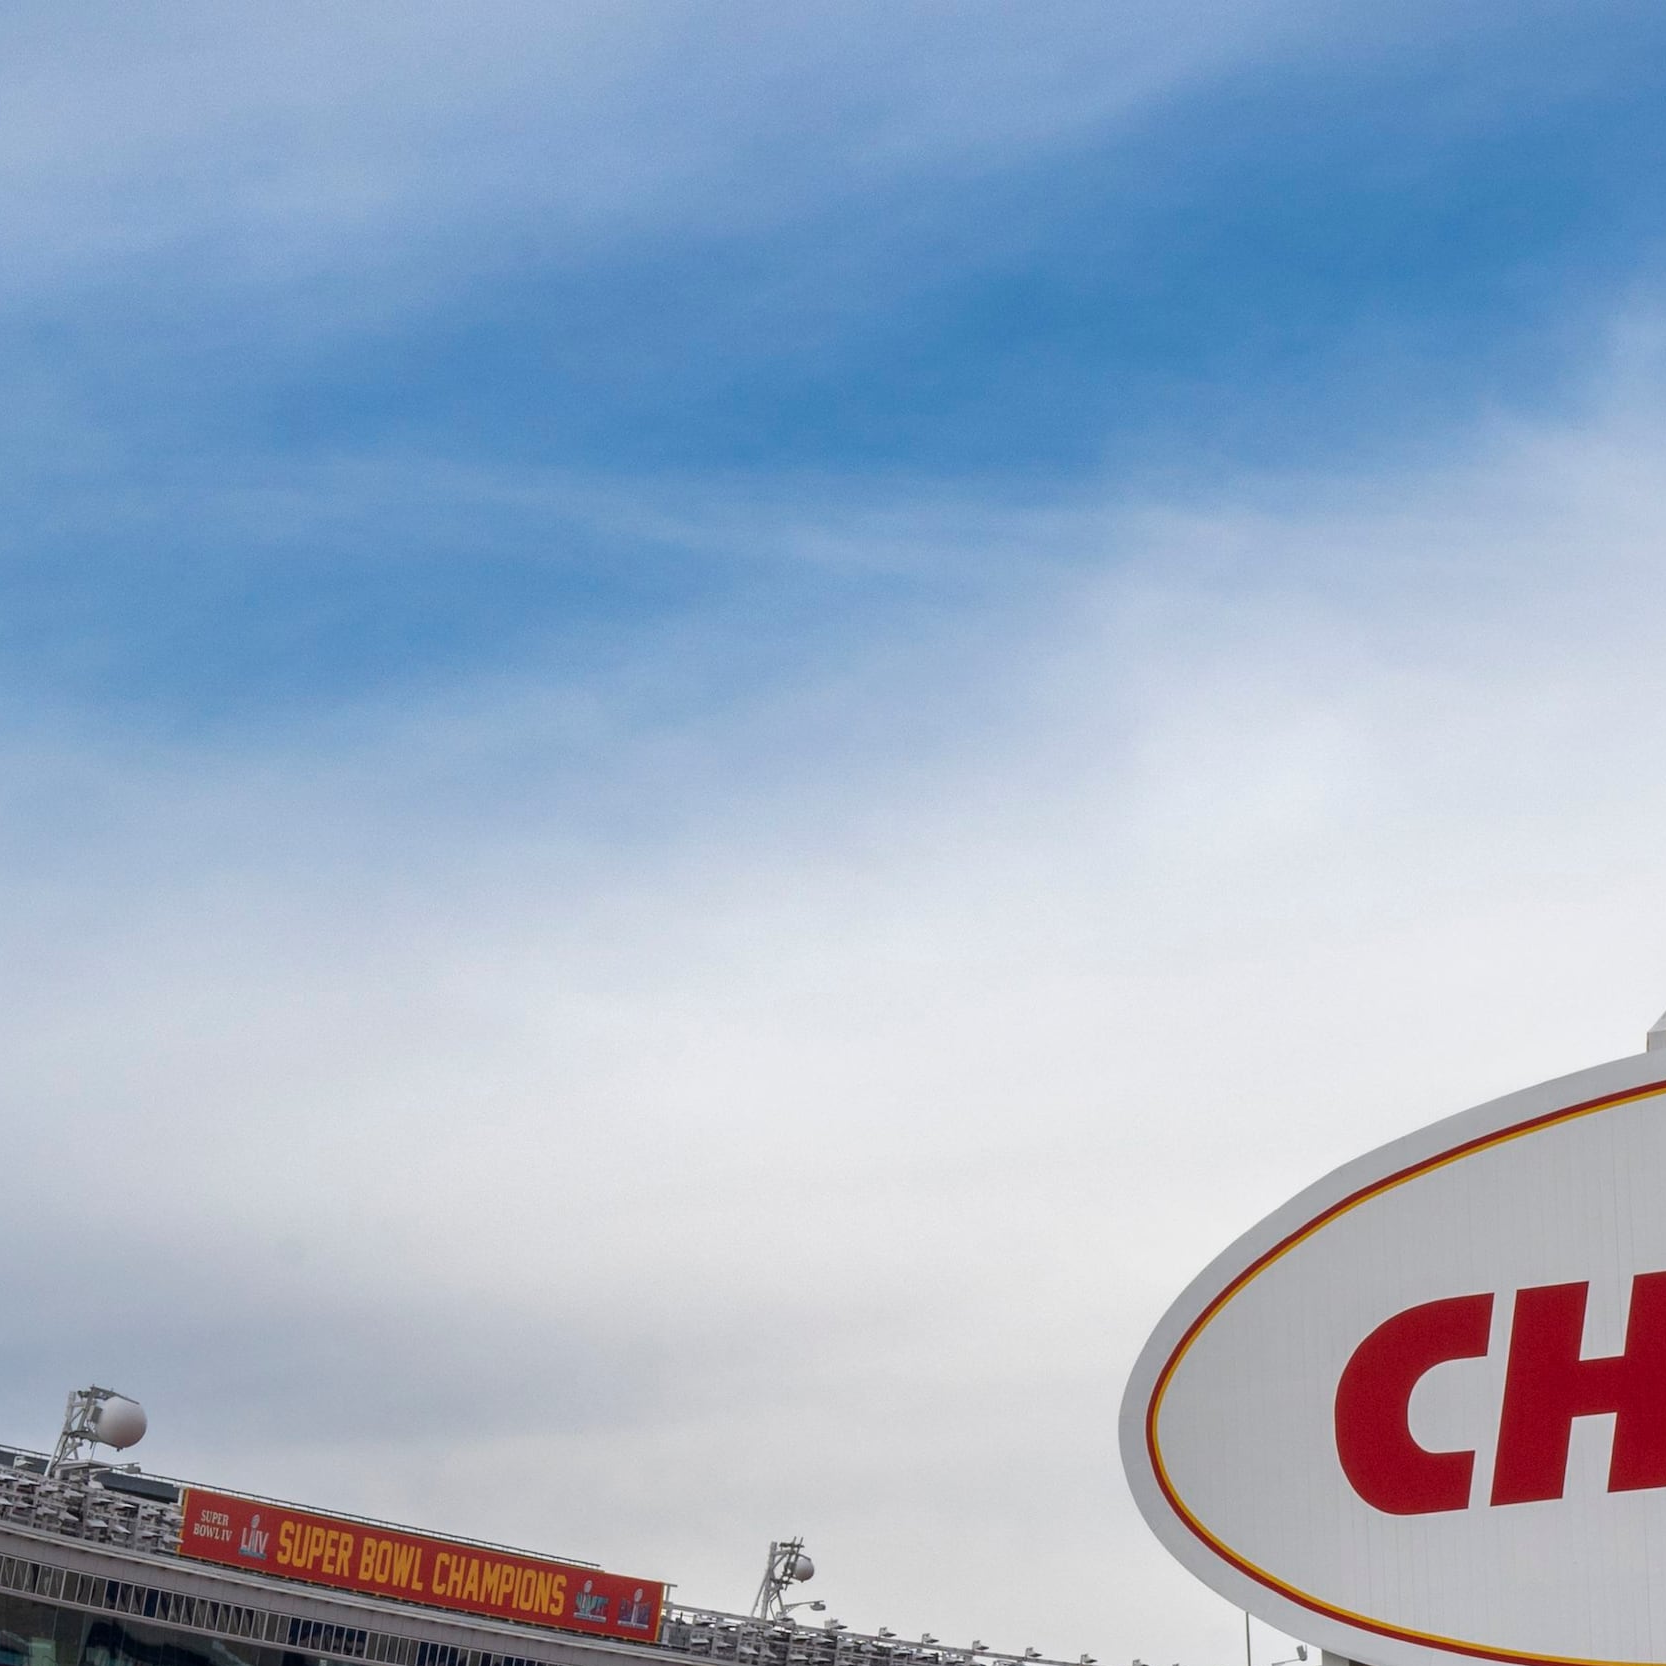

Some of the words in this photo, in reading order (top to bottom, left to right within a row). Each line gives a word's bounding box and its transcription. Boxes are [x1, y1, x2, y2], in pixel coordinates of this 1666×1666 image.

[200, 1509, 229, 1526] SUPER
[193, 1523, 222, 1541] BOWL
[220, 1530, 232, 1542] IV
[276, 1520, 354, 1577] SUPER
[358, 1537, 423, 1591] BOWL
[432, 1552, 567, 1617] CHAMPIONS
